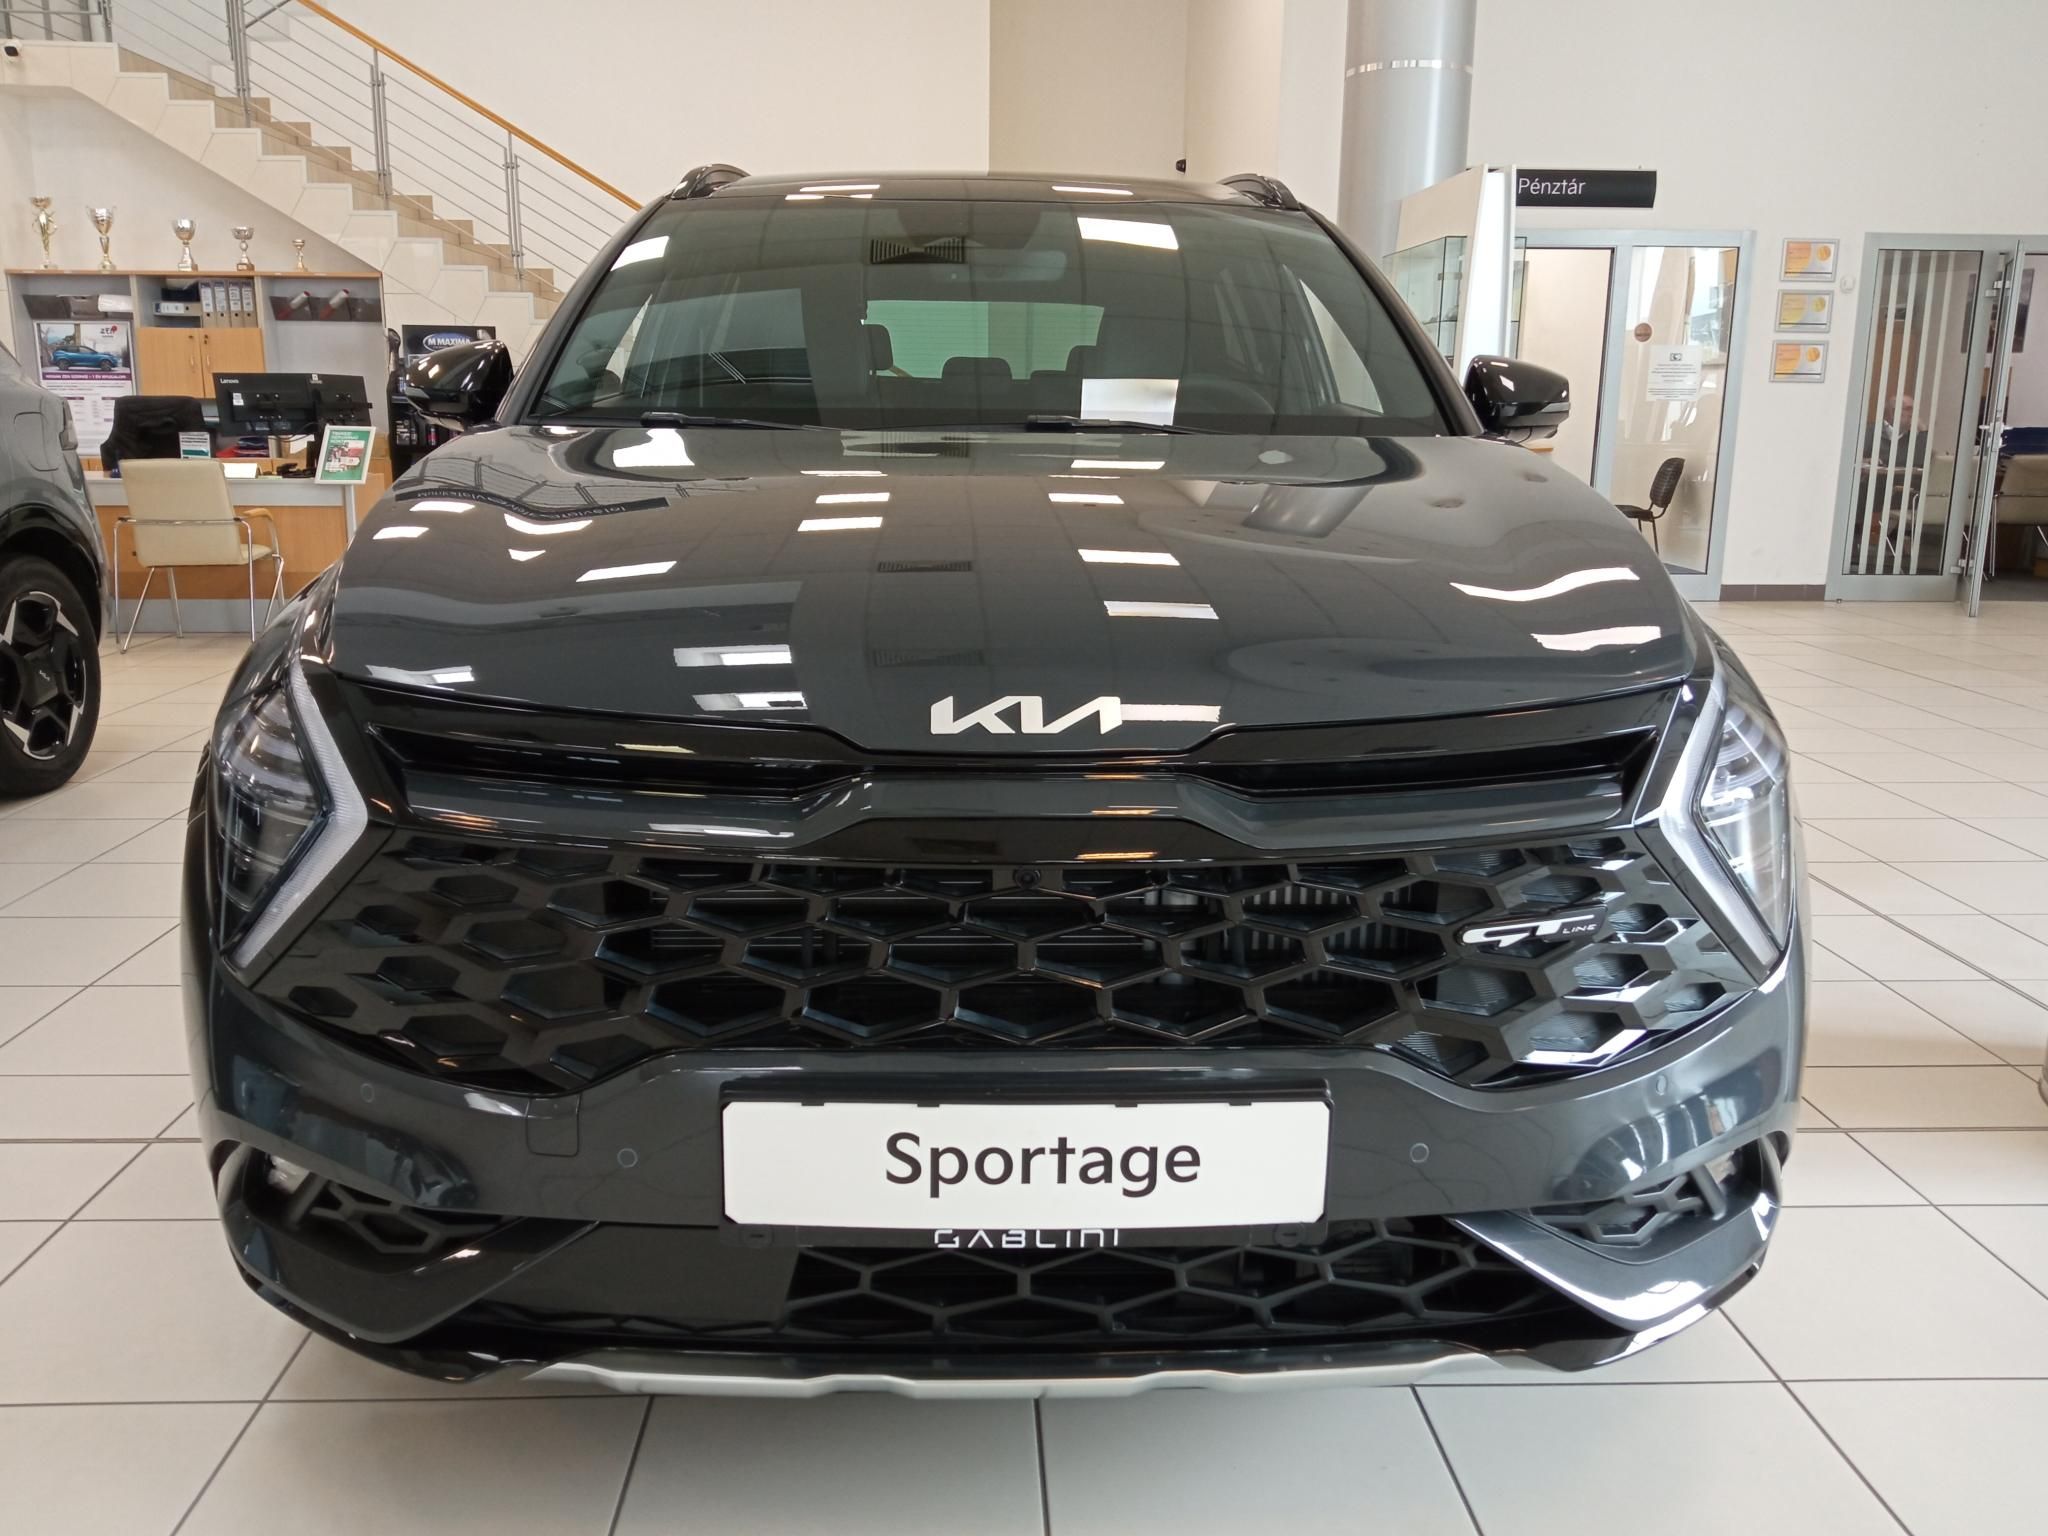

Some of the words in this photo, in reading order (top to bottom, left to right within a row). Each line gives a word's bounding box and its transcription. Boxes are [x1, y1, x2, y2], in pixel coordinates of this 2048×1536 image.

[1518, 177, 1586, 195] Pénztár
[930, 695, 1123, 735] KIA
[1462, 914, 1595, 948] GT
[1562, 923, 1597, 934] LINE
[885, 1131, 1201, 1198] Sportage
[933, 1228, 1119, 1249] GABLINI
